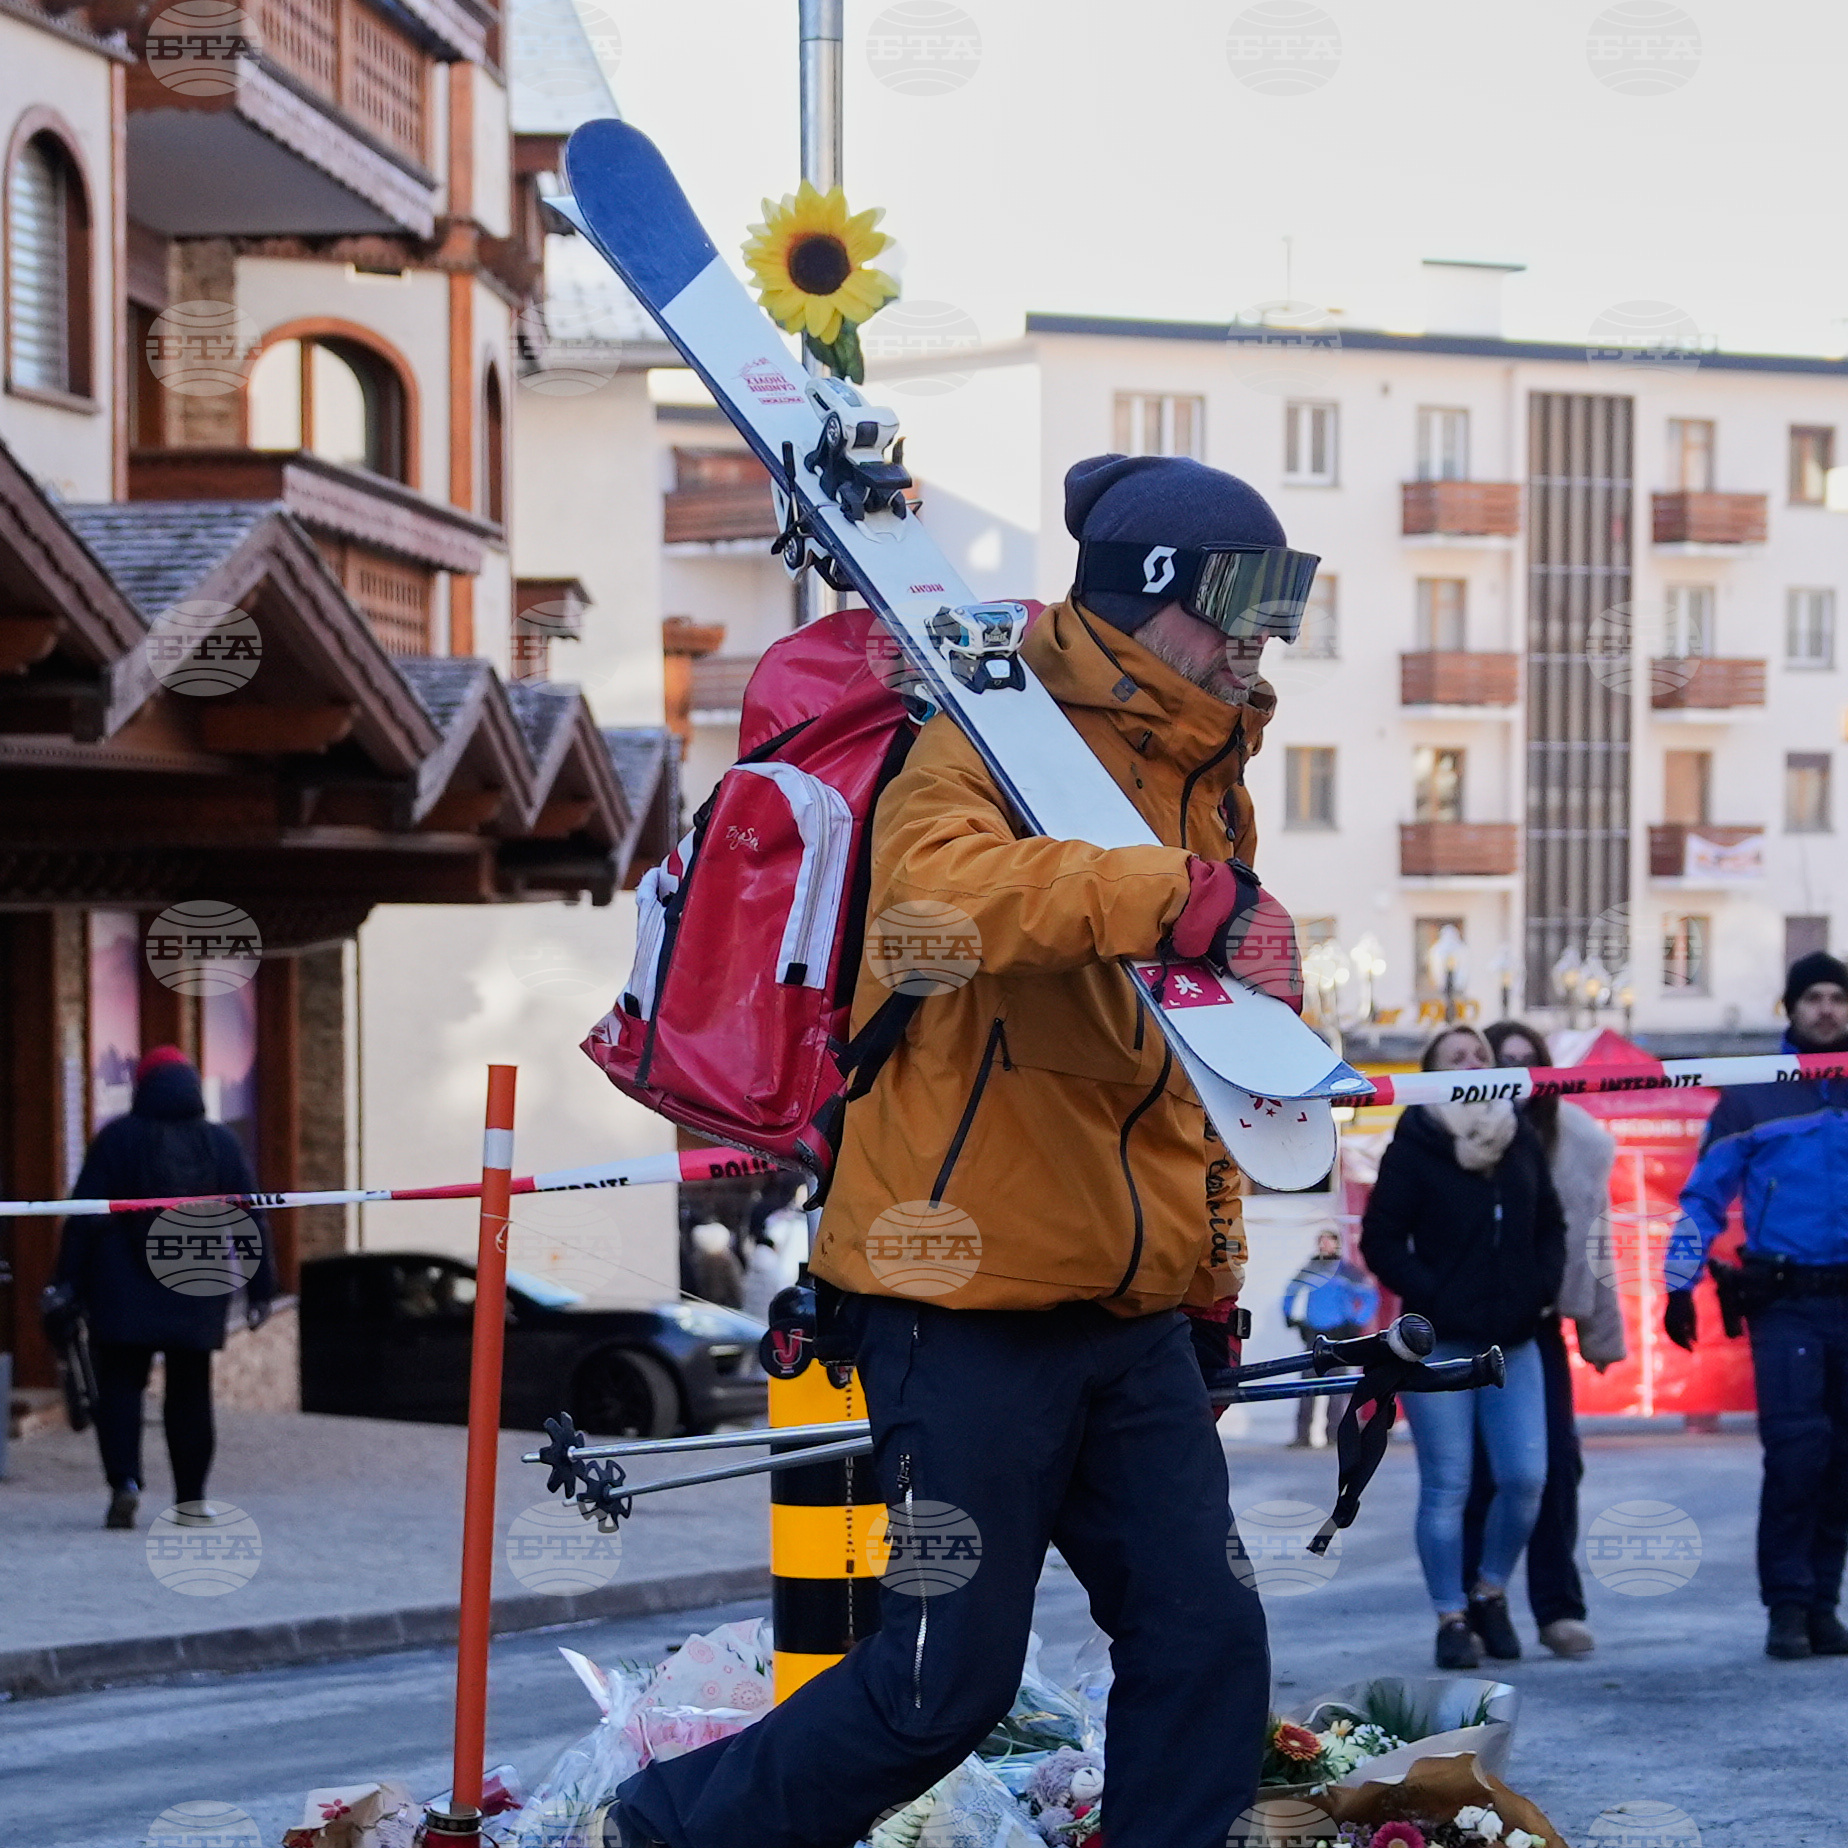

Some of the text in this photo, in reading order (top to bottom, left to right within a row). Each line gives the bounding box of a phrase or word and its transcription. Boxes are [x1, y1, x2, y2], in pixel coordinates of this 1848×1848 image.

[908, 583, 945, 594] RIGHT
[1452, 1073, 1703, 1103] POLICE ZONE INTERDITE
